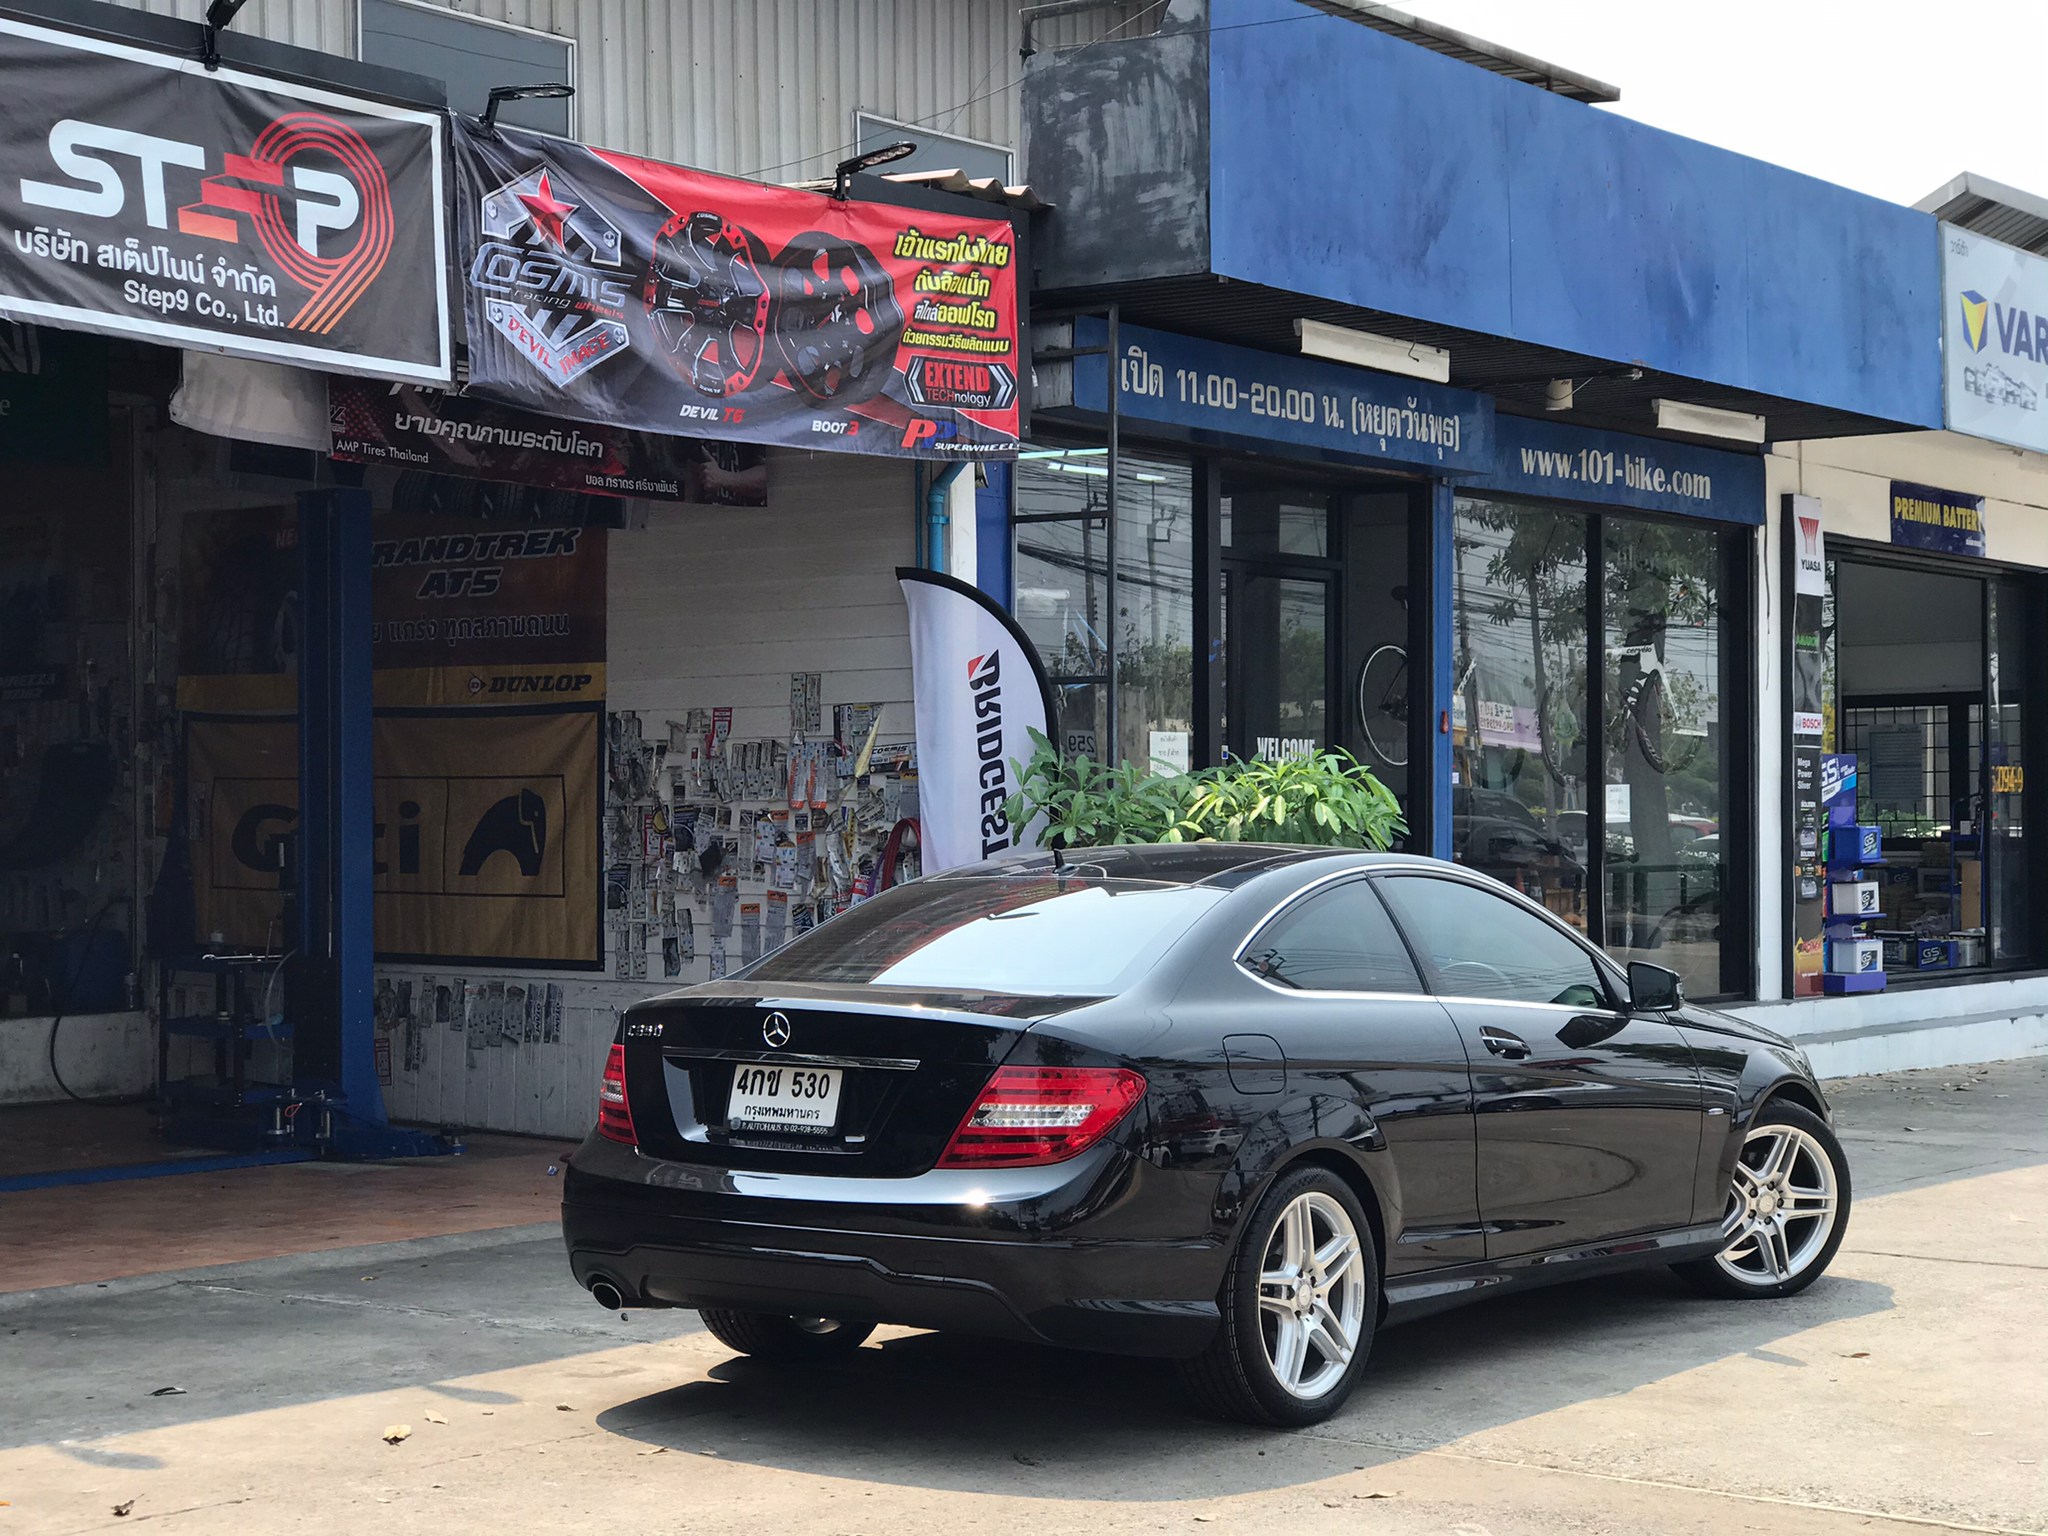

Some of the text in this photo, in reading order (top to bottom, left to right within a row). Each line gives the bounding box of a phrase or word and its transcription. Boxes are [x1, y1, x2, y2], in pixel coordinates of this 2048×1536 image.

[14, 226, 277, 297] บริษัท สเต็ปไนน์ จำกัด
[123, 280, 285, 328] Step9 Co., Ltd.
[514, 289, 624, 320] racing wheels
[559, 330, 612, 375] IMAGE
[925, 361, 991, 392] EXTEND
[926, 387, 991, 407] TECHnology
[1121, 345, 1460, 459] เปิด 11.00-20.00 น. (หยุดวันพุธ)
[680, 404, 746, 423] DEVIL T6
[395, 412, 604, 459] ยางคุณภาพระดับโลก
[812, 420, 859, 435] BOOT 3
[336, 439, 429, 464] AMP Tires Thailand
[585, 474, 602, 486] บอล
[605, 475, 635, 490] ภราดร
[1520, 447, 1711, 500] www.101-bike.com
[1894, 496, 1982, 532] PREMIUM BATTERY
[276, 529, 298, 548] NE
[372, 527, 582, 568] RANDTREK
[1801, 559, 1821, 572] YUASA
[390, 614, 438, 642] แกร่ง
[443, 613, 570, 647] ทุกสภาพถนน
[489, 674, 592, 693] DUNLOP
[1802, 717, 1822, 730] BOSCH
[1257, 737, 1316, 762] WELCOME
[1922, 946, 1940, 958] GS
[791, 1072, 830, 1099] 530
[744, 1104, 820, 1120] กรุงเทพมหานคร
[747, 1121, 782, 1132] AUTOHAUS
